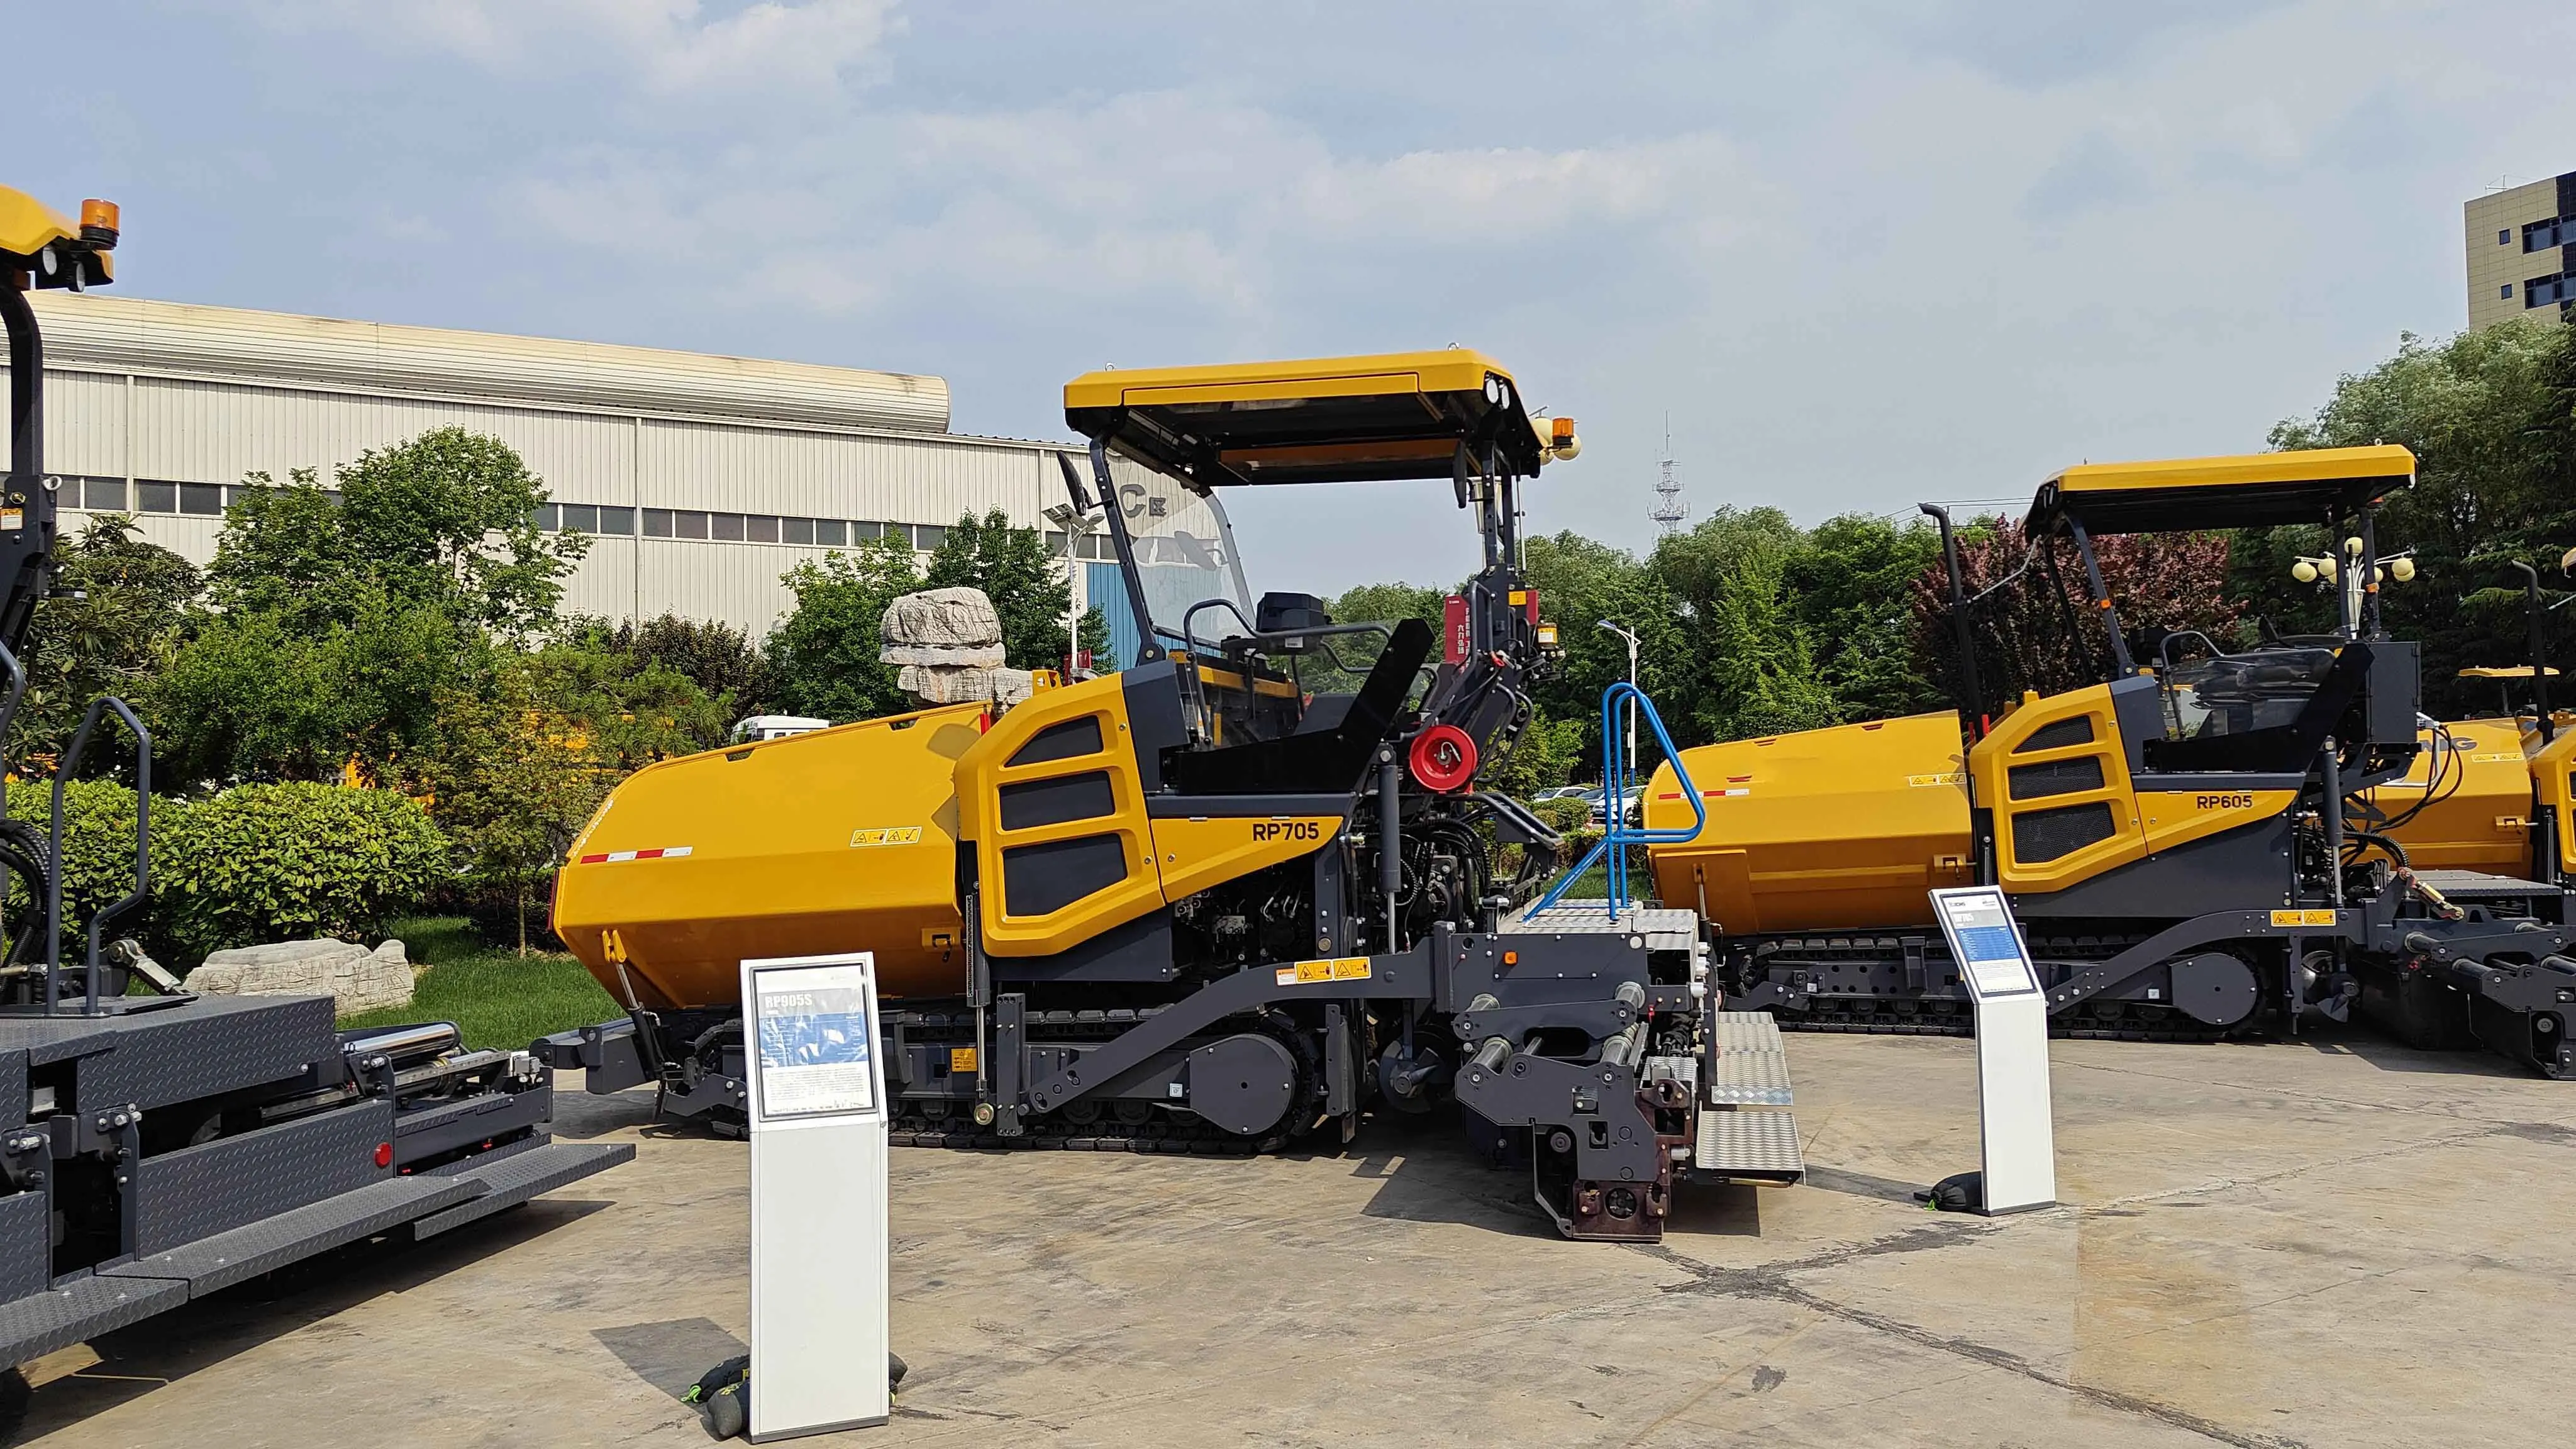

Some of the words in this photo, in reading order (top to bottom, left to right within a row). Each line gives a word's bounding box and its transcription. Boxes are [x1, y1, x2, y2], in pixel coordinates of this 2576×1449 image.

[2197, 795, 2252, 809] RP605
[1253, 822, 1319, 841] RP705
[765, 994, 813, 1008] RP905S
